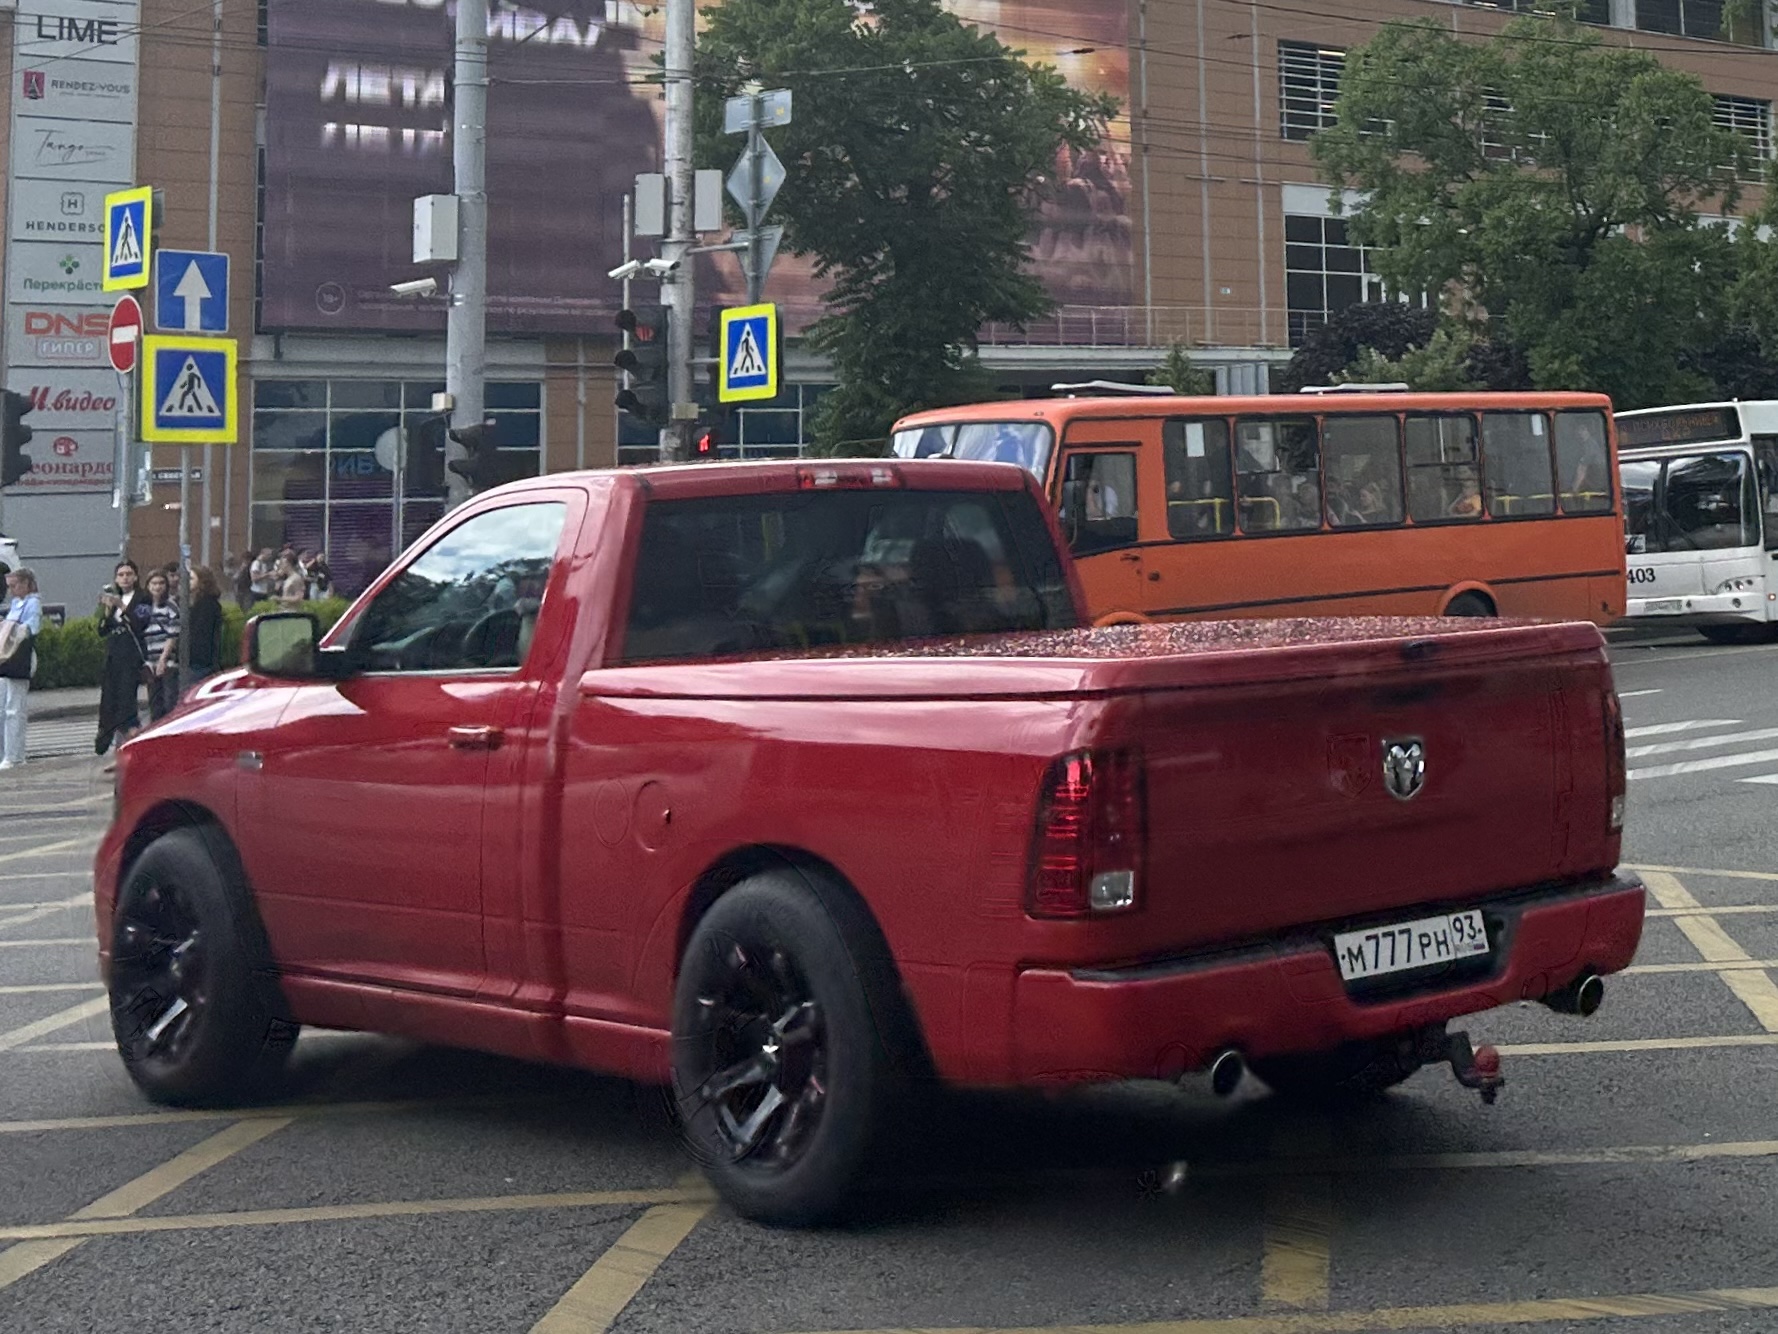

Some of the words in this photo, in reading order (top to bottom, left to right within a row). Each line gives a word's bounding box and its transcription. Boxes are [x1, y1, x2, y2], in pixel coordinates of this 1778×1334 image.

[37, 15, 118, 45] LIME
[51, 79, 131, 95] RENDEZ-VOUS
[34, 128, 100, 163] Tango
[26, 220, 105, 233] HENDERSO
[23, 278, 104, 293] Перекрёст
[24, 311, 111, 336] DNS
[42, 341, 94, 354] ГИПЕР
[30, 461, 114, 477] еонардо
[1452, 914, 1476, 943] 93
